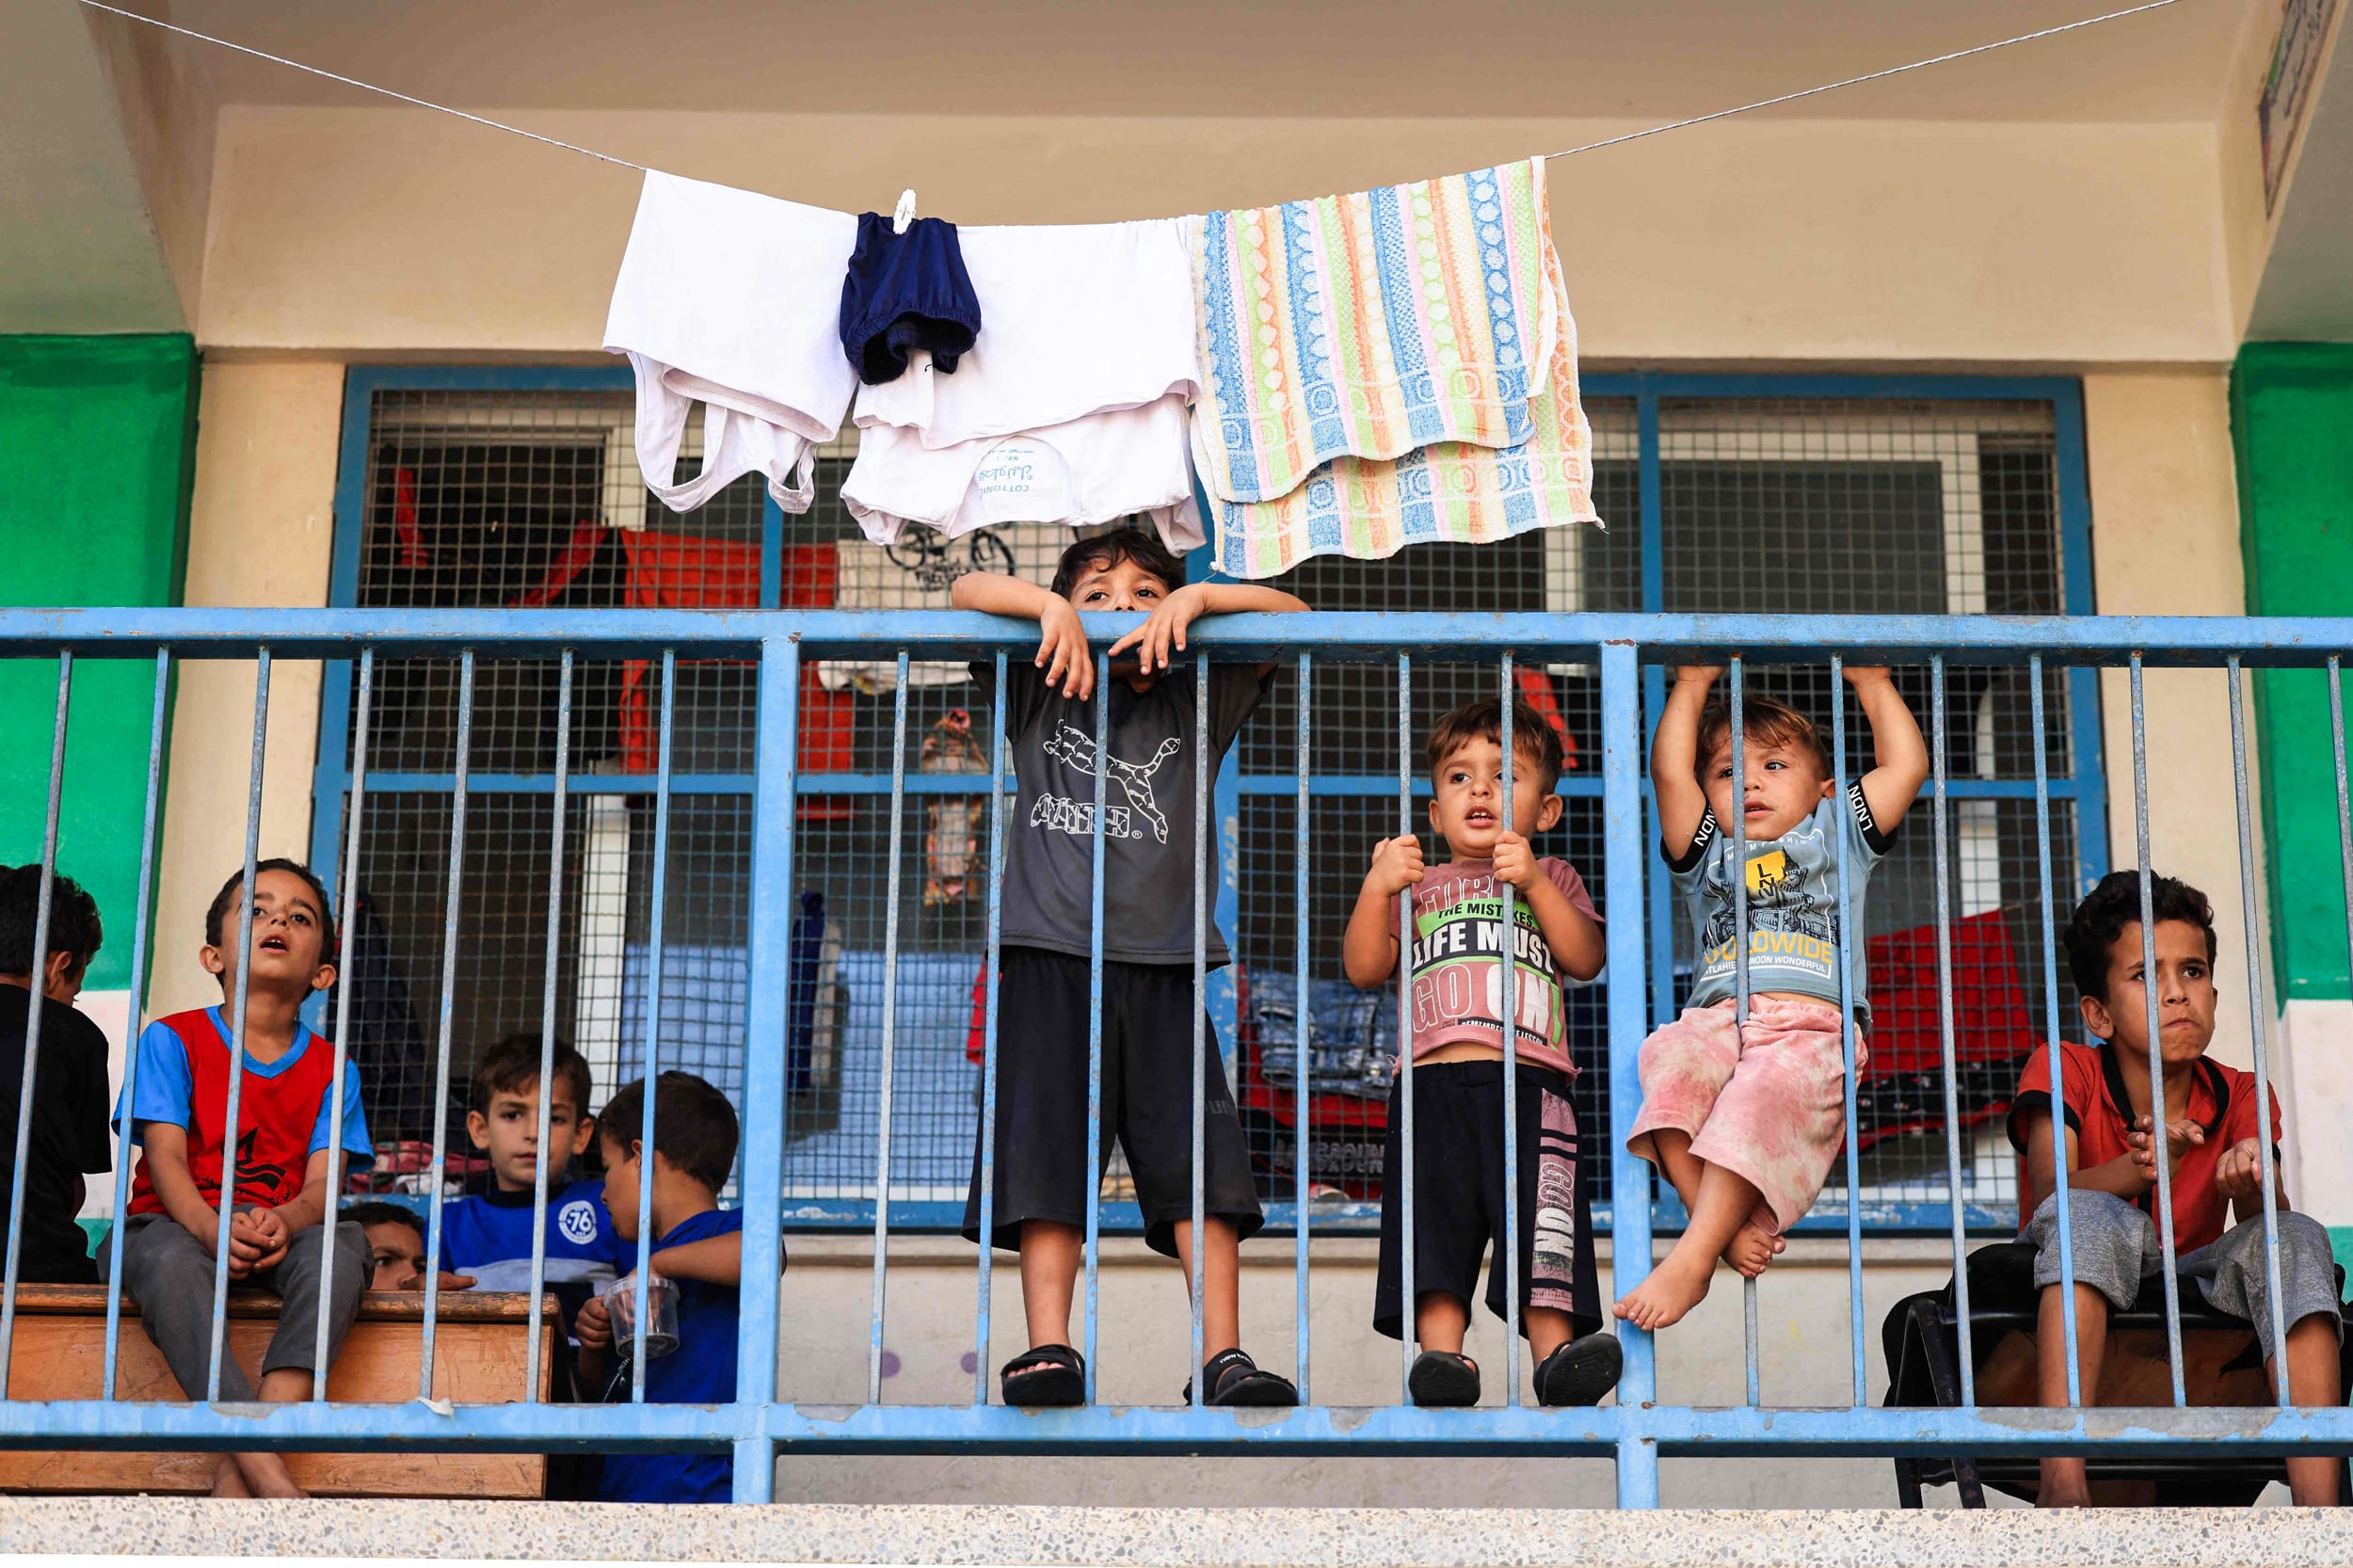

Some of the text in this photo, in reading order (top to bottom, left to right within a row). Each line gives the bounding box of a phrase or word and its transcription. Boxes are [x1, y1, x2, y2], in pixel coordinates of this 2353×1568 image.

[1438, 904, 1537, 929] THE MISTKES.
[1413, 921, 1555, 975] LIFE MUST
[1773, 954, 1827, 973] WONDERFUL
[1412, 963, 1550, 1035] GO ON
[1538, 1161, 1575, 1210] GO
[569, 1210, 592, 1232] 76
[1533, 1207, 1575, 1259] ON
